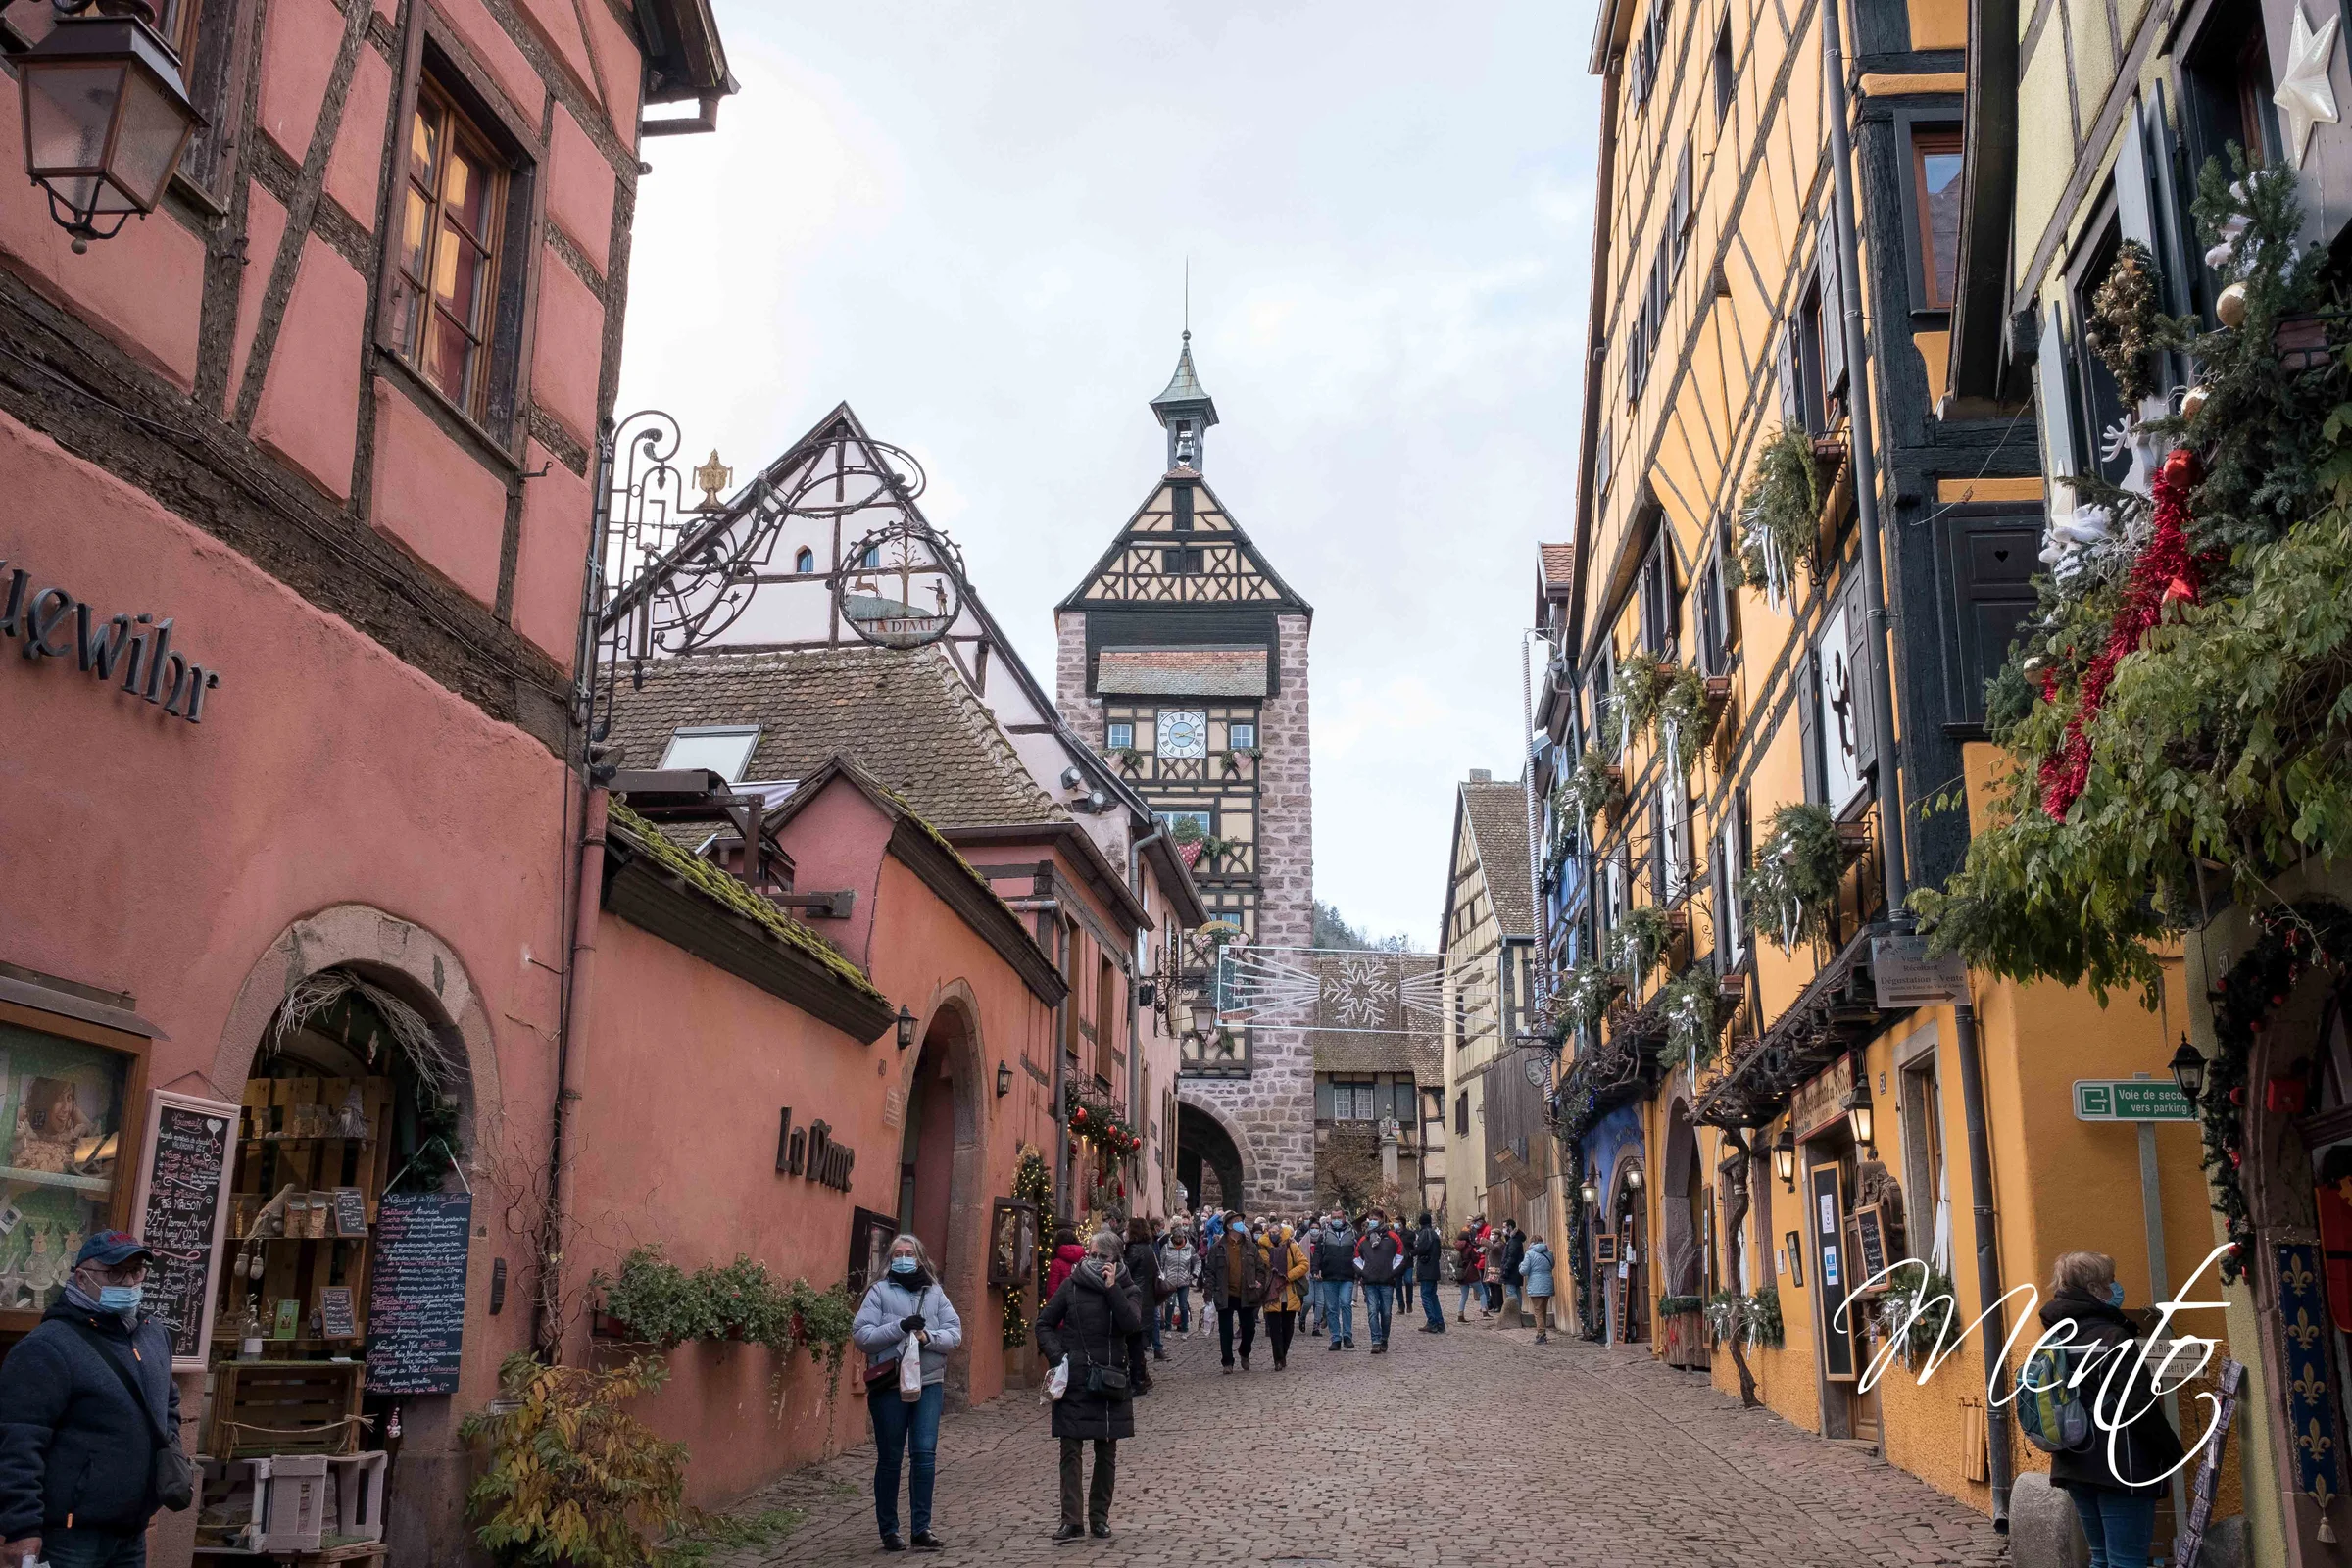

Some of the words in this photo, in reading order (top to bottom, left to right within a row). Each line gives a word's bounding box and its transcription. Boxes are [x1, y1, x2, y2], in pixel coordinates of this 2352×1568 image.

[1881, 976, 1931, 986] Dégustation
[1939, 974, 1964, 983] Vente
[2118, 1089, 2140, 1100] Voie
[2142, 1089, 2155, 1100] de
[2159, 1091, 2187, 1101] seco
[2153, 1103, 2188, 1114] parking
[775, 1106, 808, 1176] La
